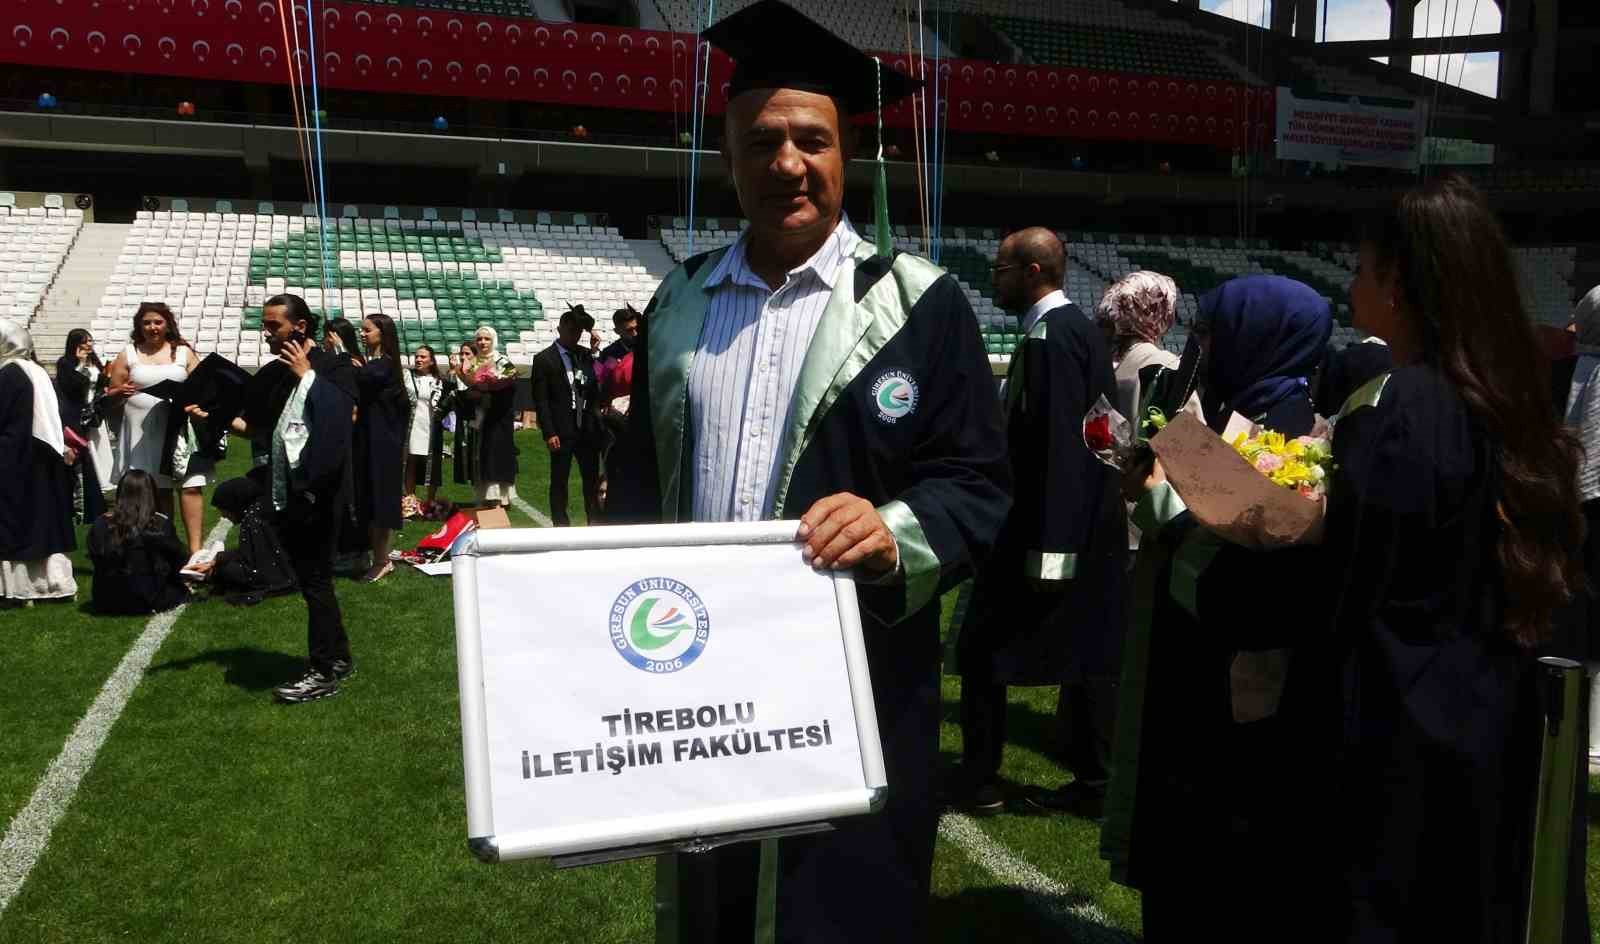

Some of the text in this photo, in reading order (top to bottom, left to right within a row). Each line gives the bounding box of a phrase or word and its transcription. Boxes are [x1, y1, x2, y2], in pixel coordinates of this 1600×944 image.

[611, 576, 708, 649] GİRESUN ÜNİVERSİTESİ
[646, 658, 683, 673] 2006
[601, 700, 755, 737] TİREBOLU
[521, 718, 834, 779] İLETİŞİM FAKÜLTESİ
